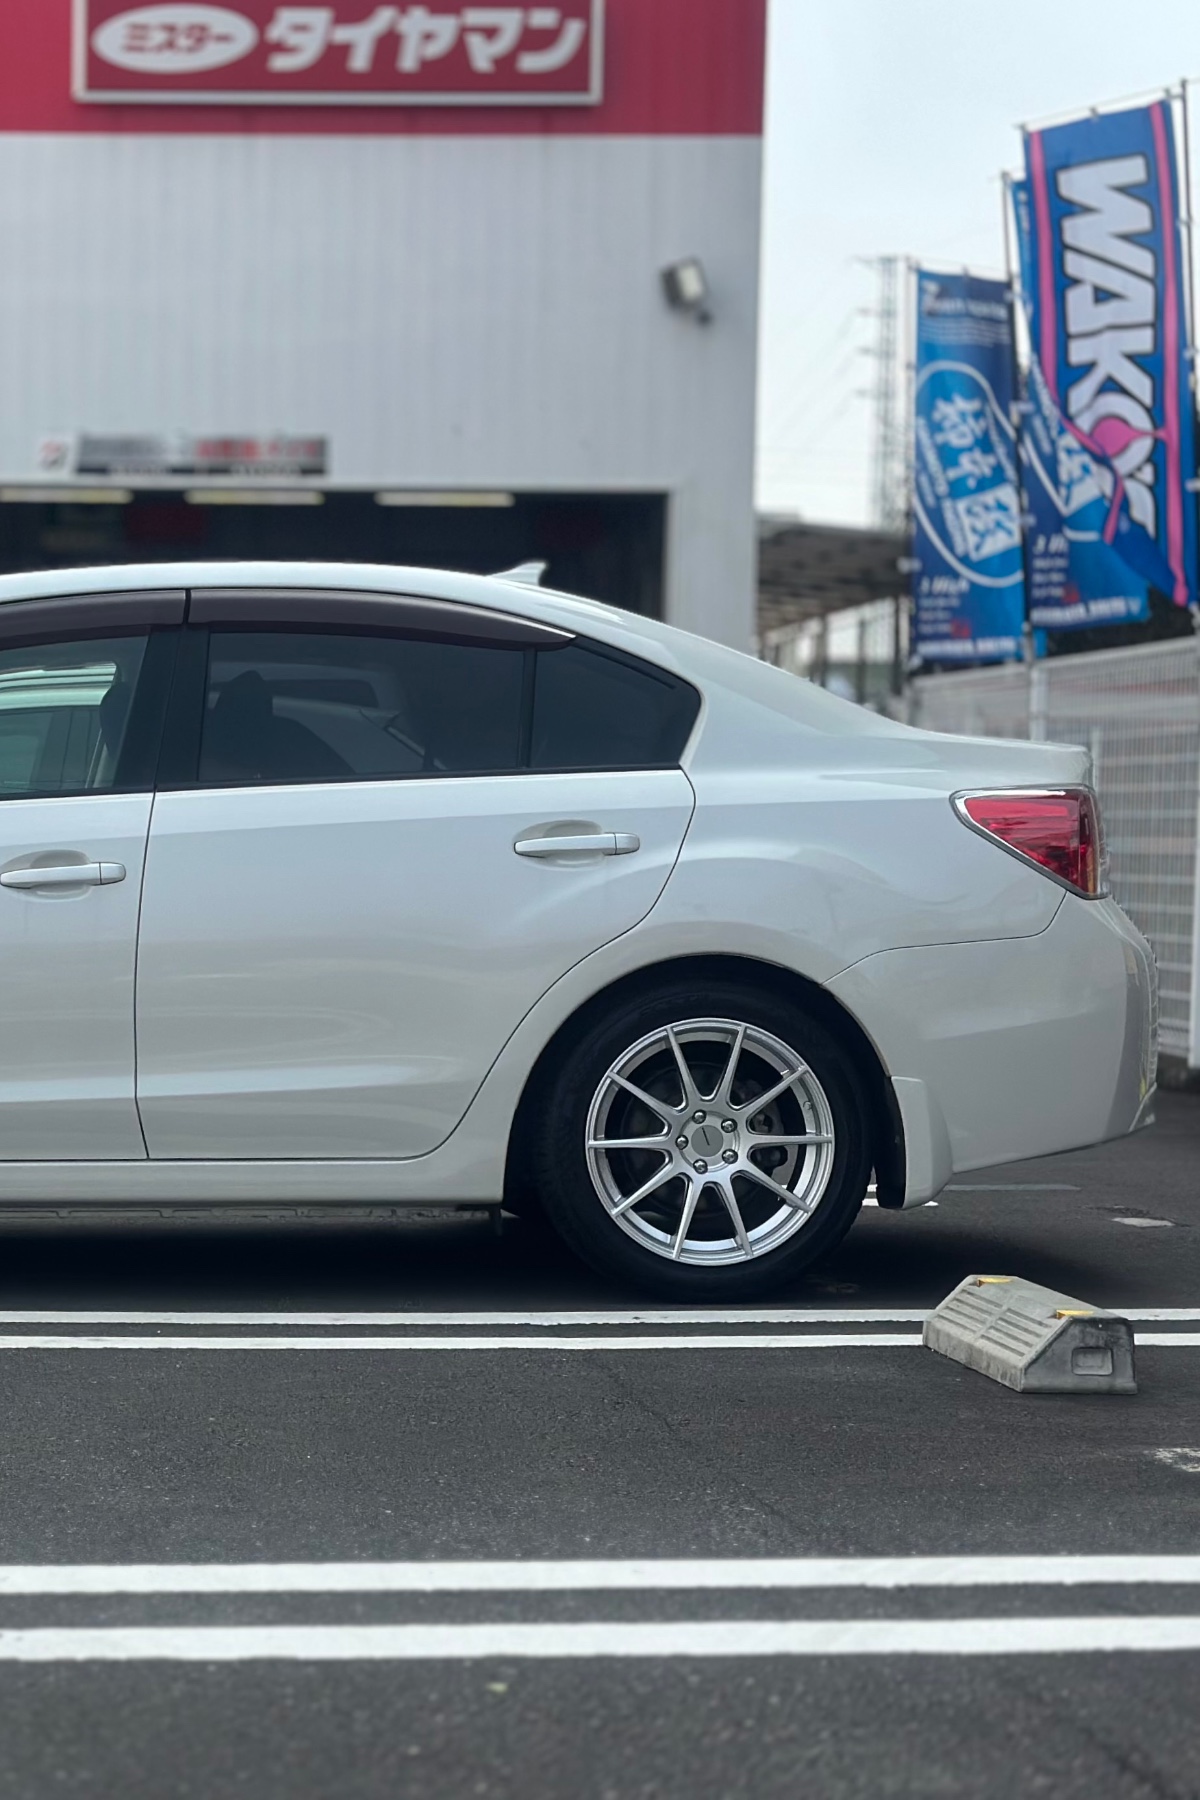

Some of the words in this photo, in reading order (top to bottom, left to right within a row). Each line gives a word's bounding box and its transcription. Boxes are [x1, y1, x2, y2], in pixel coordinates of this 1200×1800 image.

[121, 21, 237, 53] ミスター
[265, 6, 586, 74] タイヤマン
